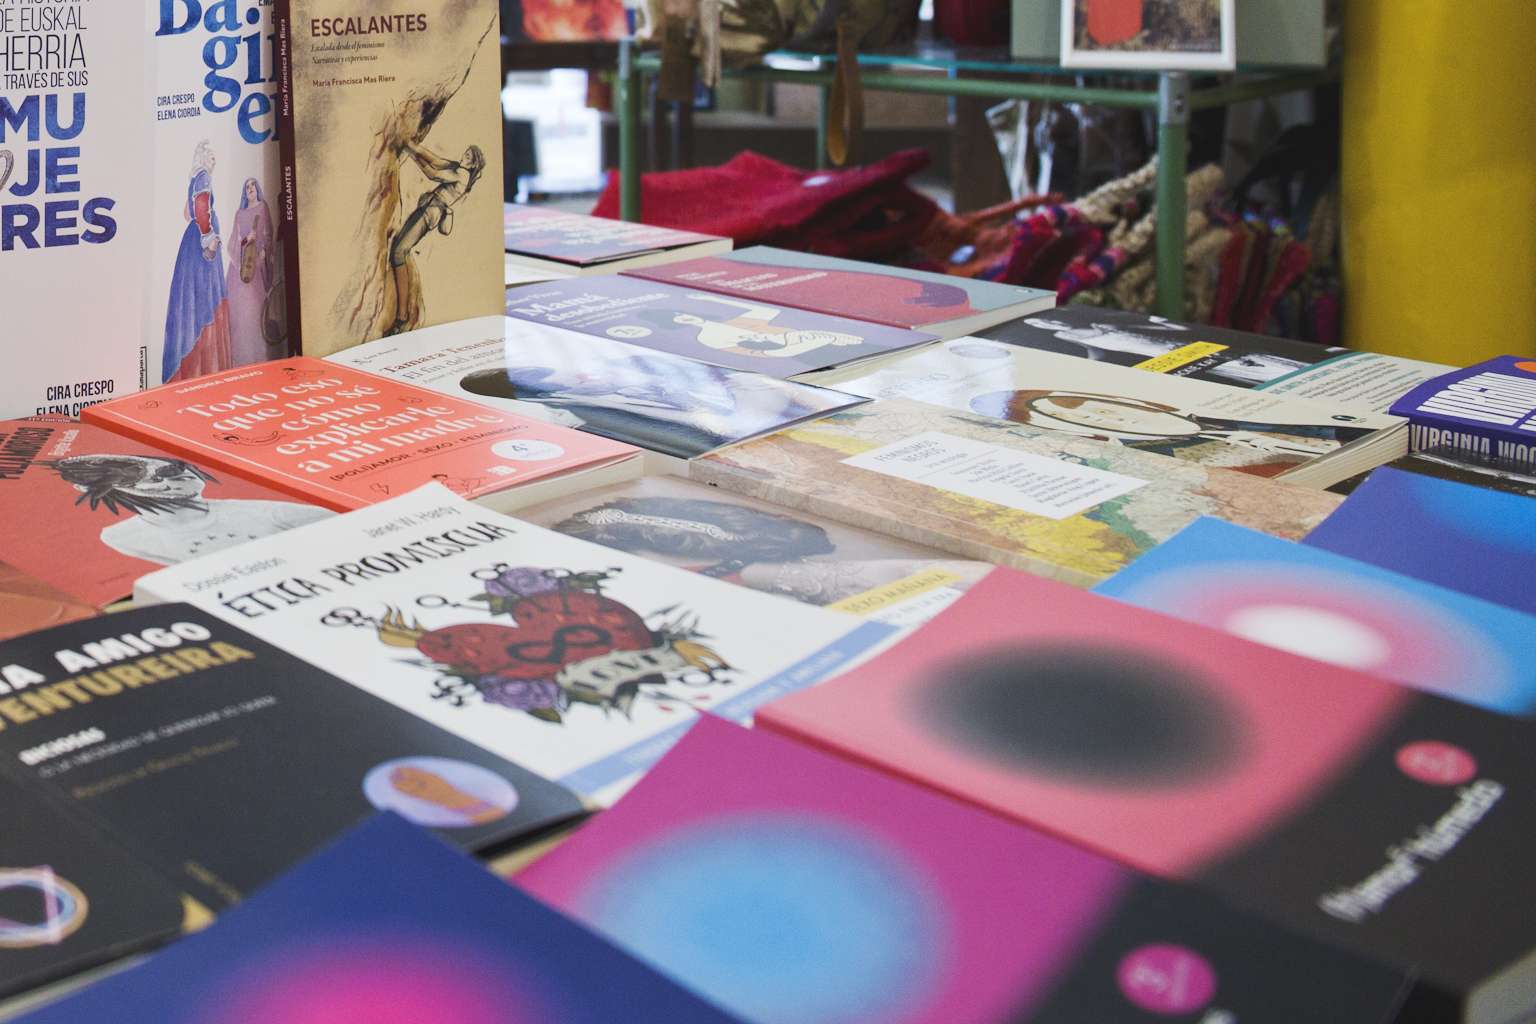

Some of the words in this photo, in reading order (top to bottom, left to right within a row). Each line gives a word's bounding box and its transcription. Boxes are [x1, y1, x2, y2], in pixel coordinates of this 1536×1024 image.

[20, 6, 88, 32] EUSKAL
[311, 13, 428, 38] ESCALANTES
[280, 38, 288, 56] Mas
[3, 70, 48, 90] TRAVÉS
[50, 72, 65, 87] DE
[67, 70, 89, 87] SUS
[332, 77, 363, 87] Francisca
[363, 75, 377, 84] Mas
[378, 75, 396, 84] Riera
[157, 95, 171, 107] CIRA
[172, 92, 195, 105] CRESPO
[157, 109, 176, 121] ELENA
[177, 106, 201, 120] CIORDIA
[8, 146, 81, 198] JE
[1, 197, 118, 252] RES
[383, 351, 444, 374] Tamara
[47, 382, 72, 402] CIRA
[74, 379, 115, 399] CRESPO
[176, 391, 278, 418] Todo
[281, 377, 344, 395] eso
[212, 405, 285, 432] que
[285, 394, 335, 412] no
[335, 383, 382, 400] sé
[281, 402, 382, 431] cómo
[275, 405, 456, 456] explicarle
[297, 458, 333, 474] a
[327, 439, 385, 464] mi
[380, 413, 505, 448] madre
[1410, 423, 1491, 456] VIRGINIA
[416, 439, 454, 455] SEXO
[364, 519, 400, 539] Janet
[416, 505, 463, 526] Hardy
[216, 576, 334, 619] ÉTICA
[320, 521, 518, 587] PROMISCUA
[54, 621, 213, 675] AMIGO
